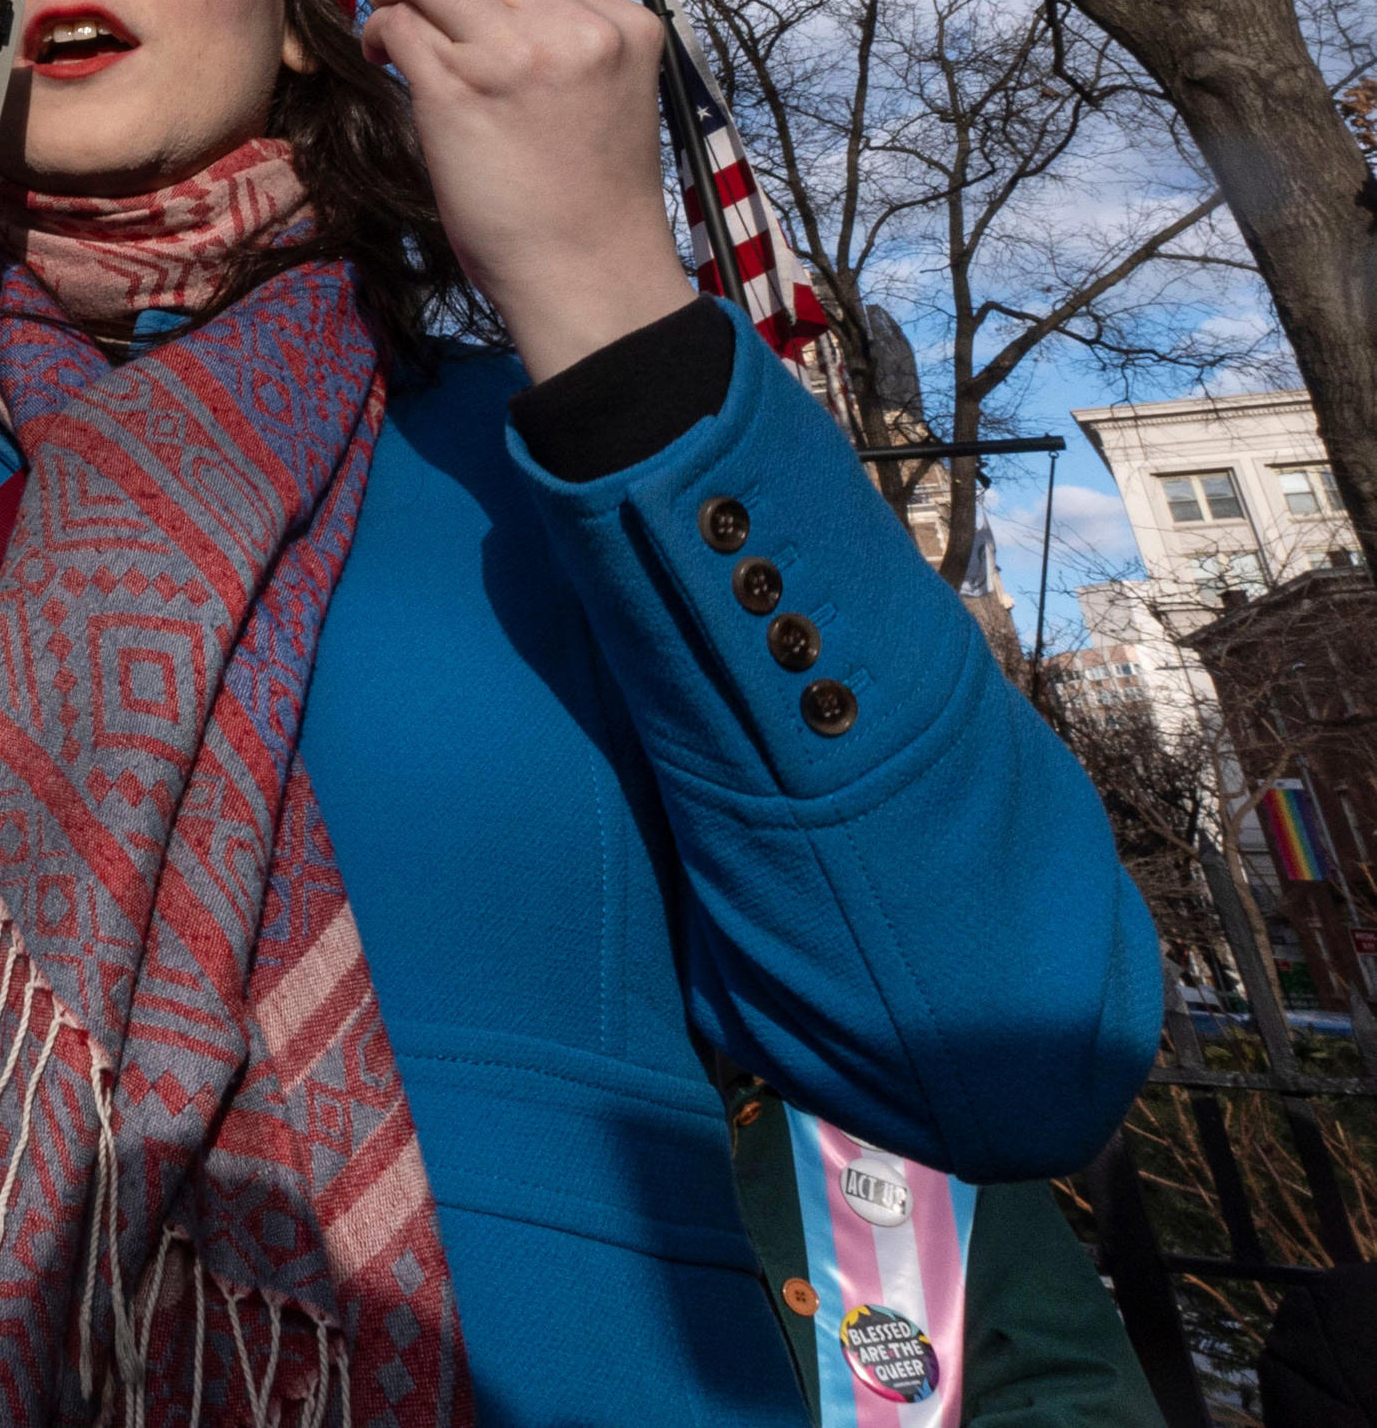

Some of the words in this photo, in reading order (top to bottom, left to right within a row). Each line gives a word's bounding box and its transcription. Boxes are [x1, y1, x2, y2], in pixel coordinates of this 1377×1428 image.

[848, 1170, 878, 1201] ACT
[849, 1321, 912, 1346] BLESSED
[859, 1344, 890, 1363] ARE
[888, 1339, 924, 1358] THE
[875, 1359, 926, 1381] QUEER
